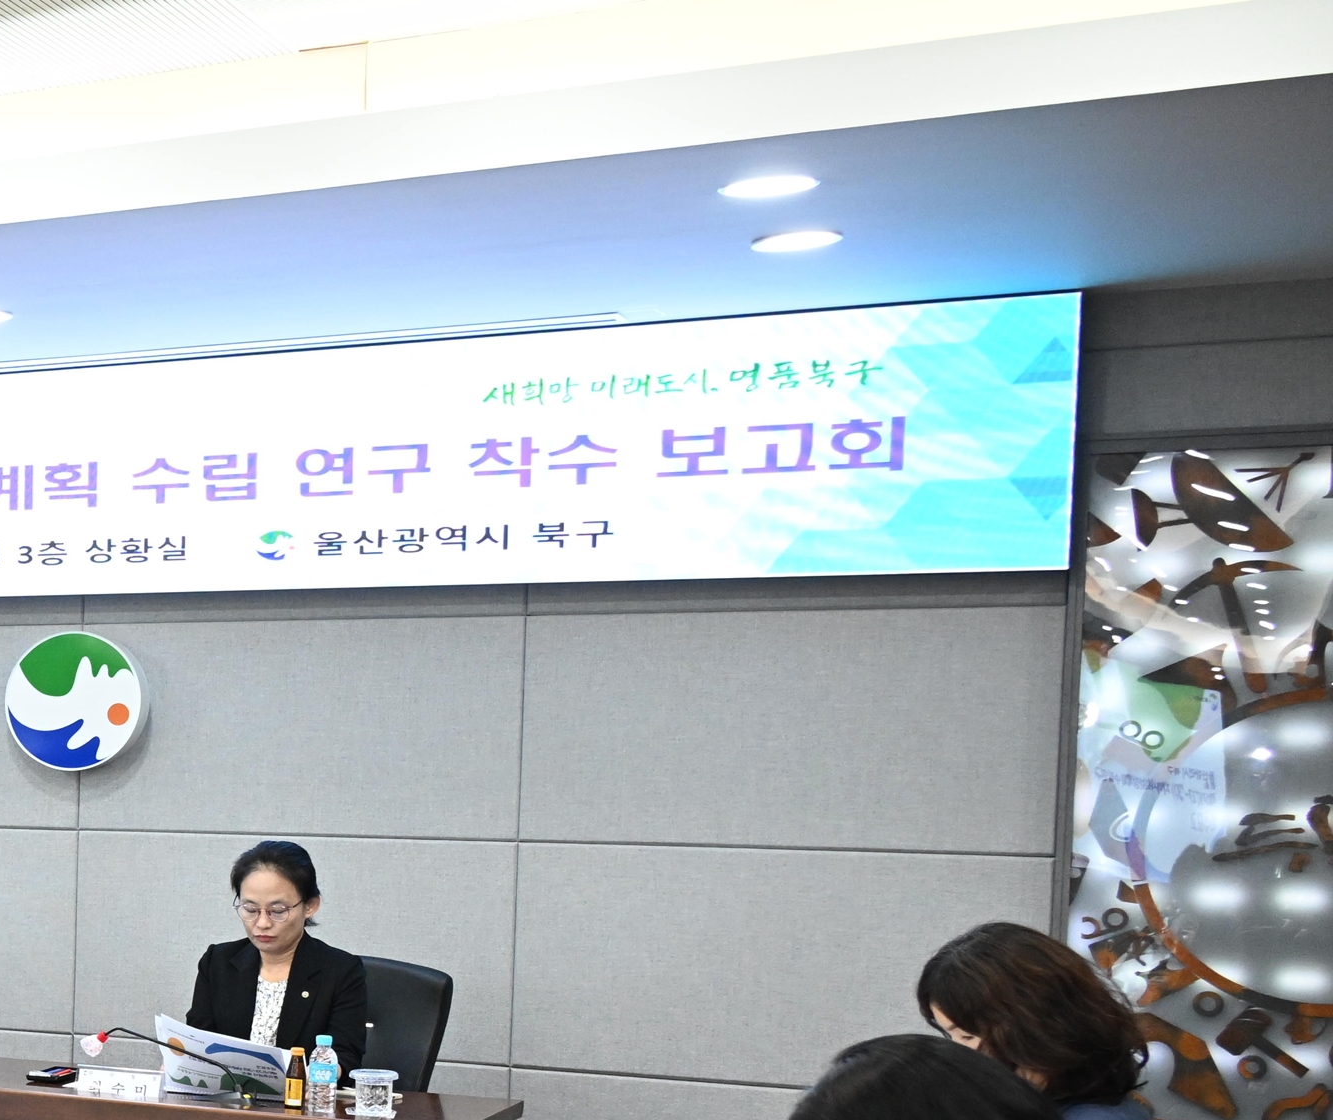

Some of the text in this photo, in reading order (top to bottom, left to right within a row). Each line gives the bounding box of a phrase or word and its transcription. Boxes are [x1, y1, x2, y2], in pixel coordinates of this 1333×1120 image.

[482, 377, 579, 406] 새희망
[729, 359, 883, 393] 명품북구
[132, 452, 259, 504] 수립
[295, 443, 432, 497] 연구
[468, 434, 619, 488] 착수
[656, 415, 908, 479] 보고회
[17, 540, 68, 566] 3층
[85, 535, 188, 564] 상황실
[313, 523, 510, 557] 울산광역시
[532, 519, 615, 550] 북구
